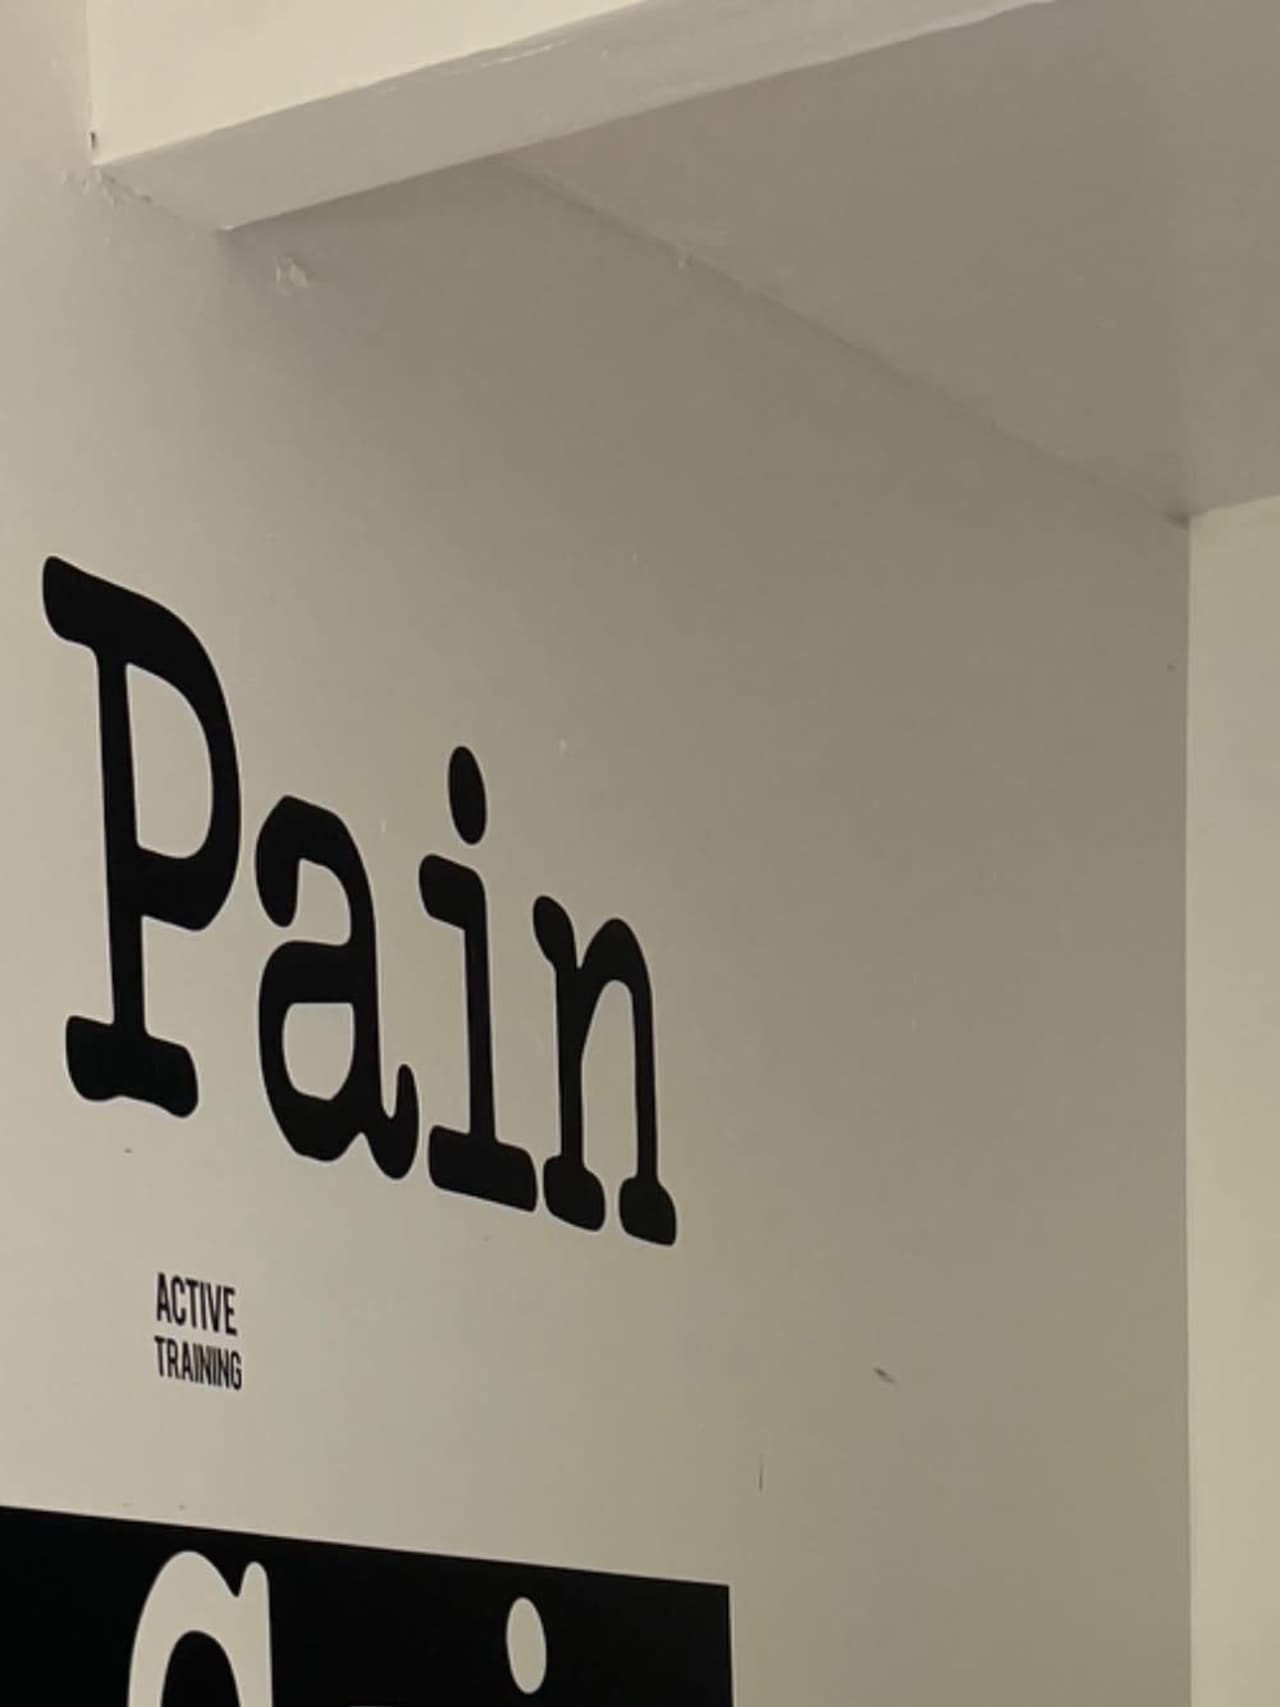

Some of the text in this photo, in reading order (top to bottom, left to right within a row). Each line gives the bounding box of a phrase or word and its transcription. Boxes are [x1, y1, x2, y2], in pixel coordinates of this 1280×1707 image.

[42, 556, 677, 1247] Pain
[156, 1272, 238, 1336] ACTIVE
[154, 1335, 243, 1391] TRAINING
